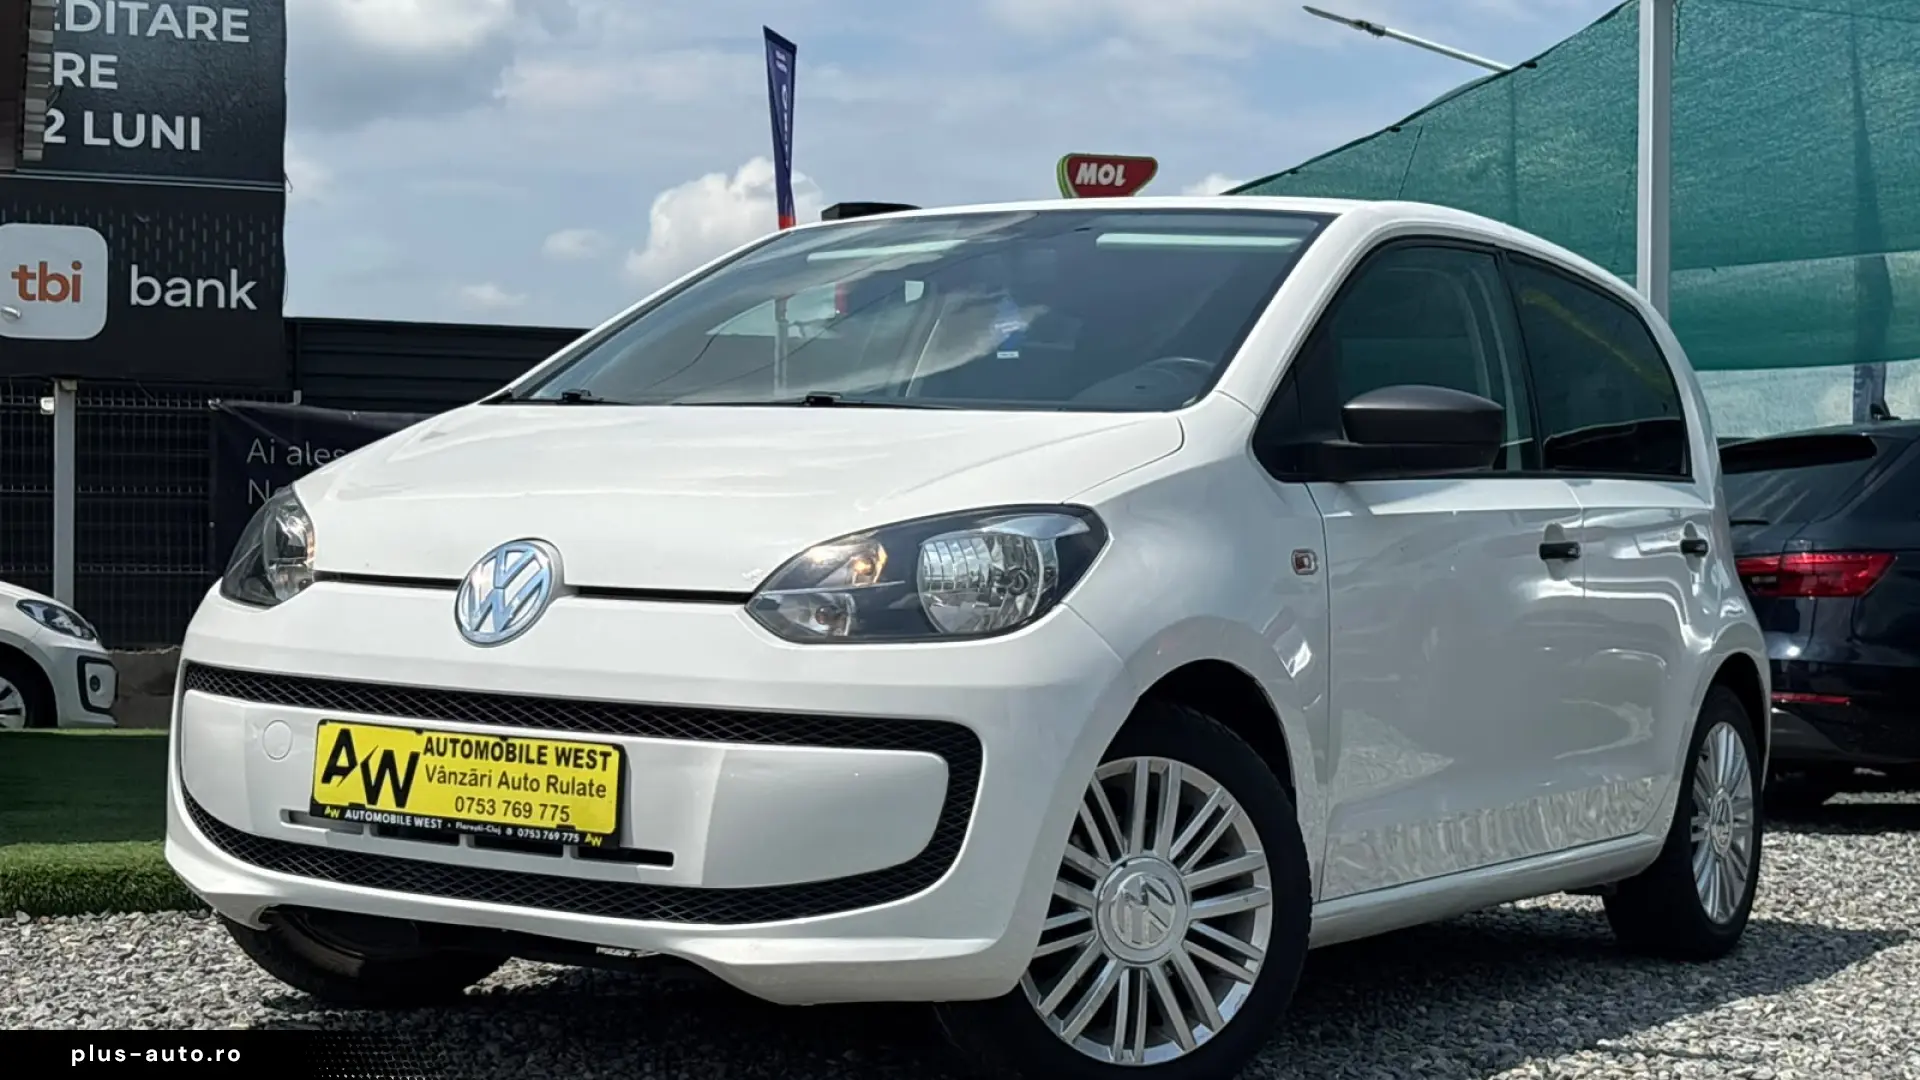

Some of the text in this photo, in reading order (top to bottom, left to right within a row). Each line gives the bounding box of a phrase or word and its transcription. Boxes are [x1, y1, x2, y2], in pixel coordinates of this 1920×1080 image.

[84, 110, 201, 151] LUNI
[1075, 162, 1126, 187] MOL
[11, 260, 258, 310] tbi bank
[246, 438, 275, 464] Ai
[423, 735, 612, 772] AUTOMOBILE WEST
[497, 770, 540, 793] Auto
[546, 774, 607, 799] Rulate
[344, 809, 412, 827] AUTOMOBILE
[413, 816, 443, 829] WEST
[454, 795, 570, 823] 0753 769 775
